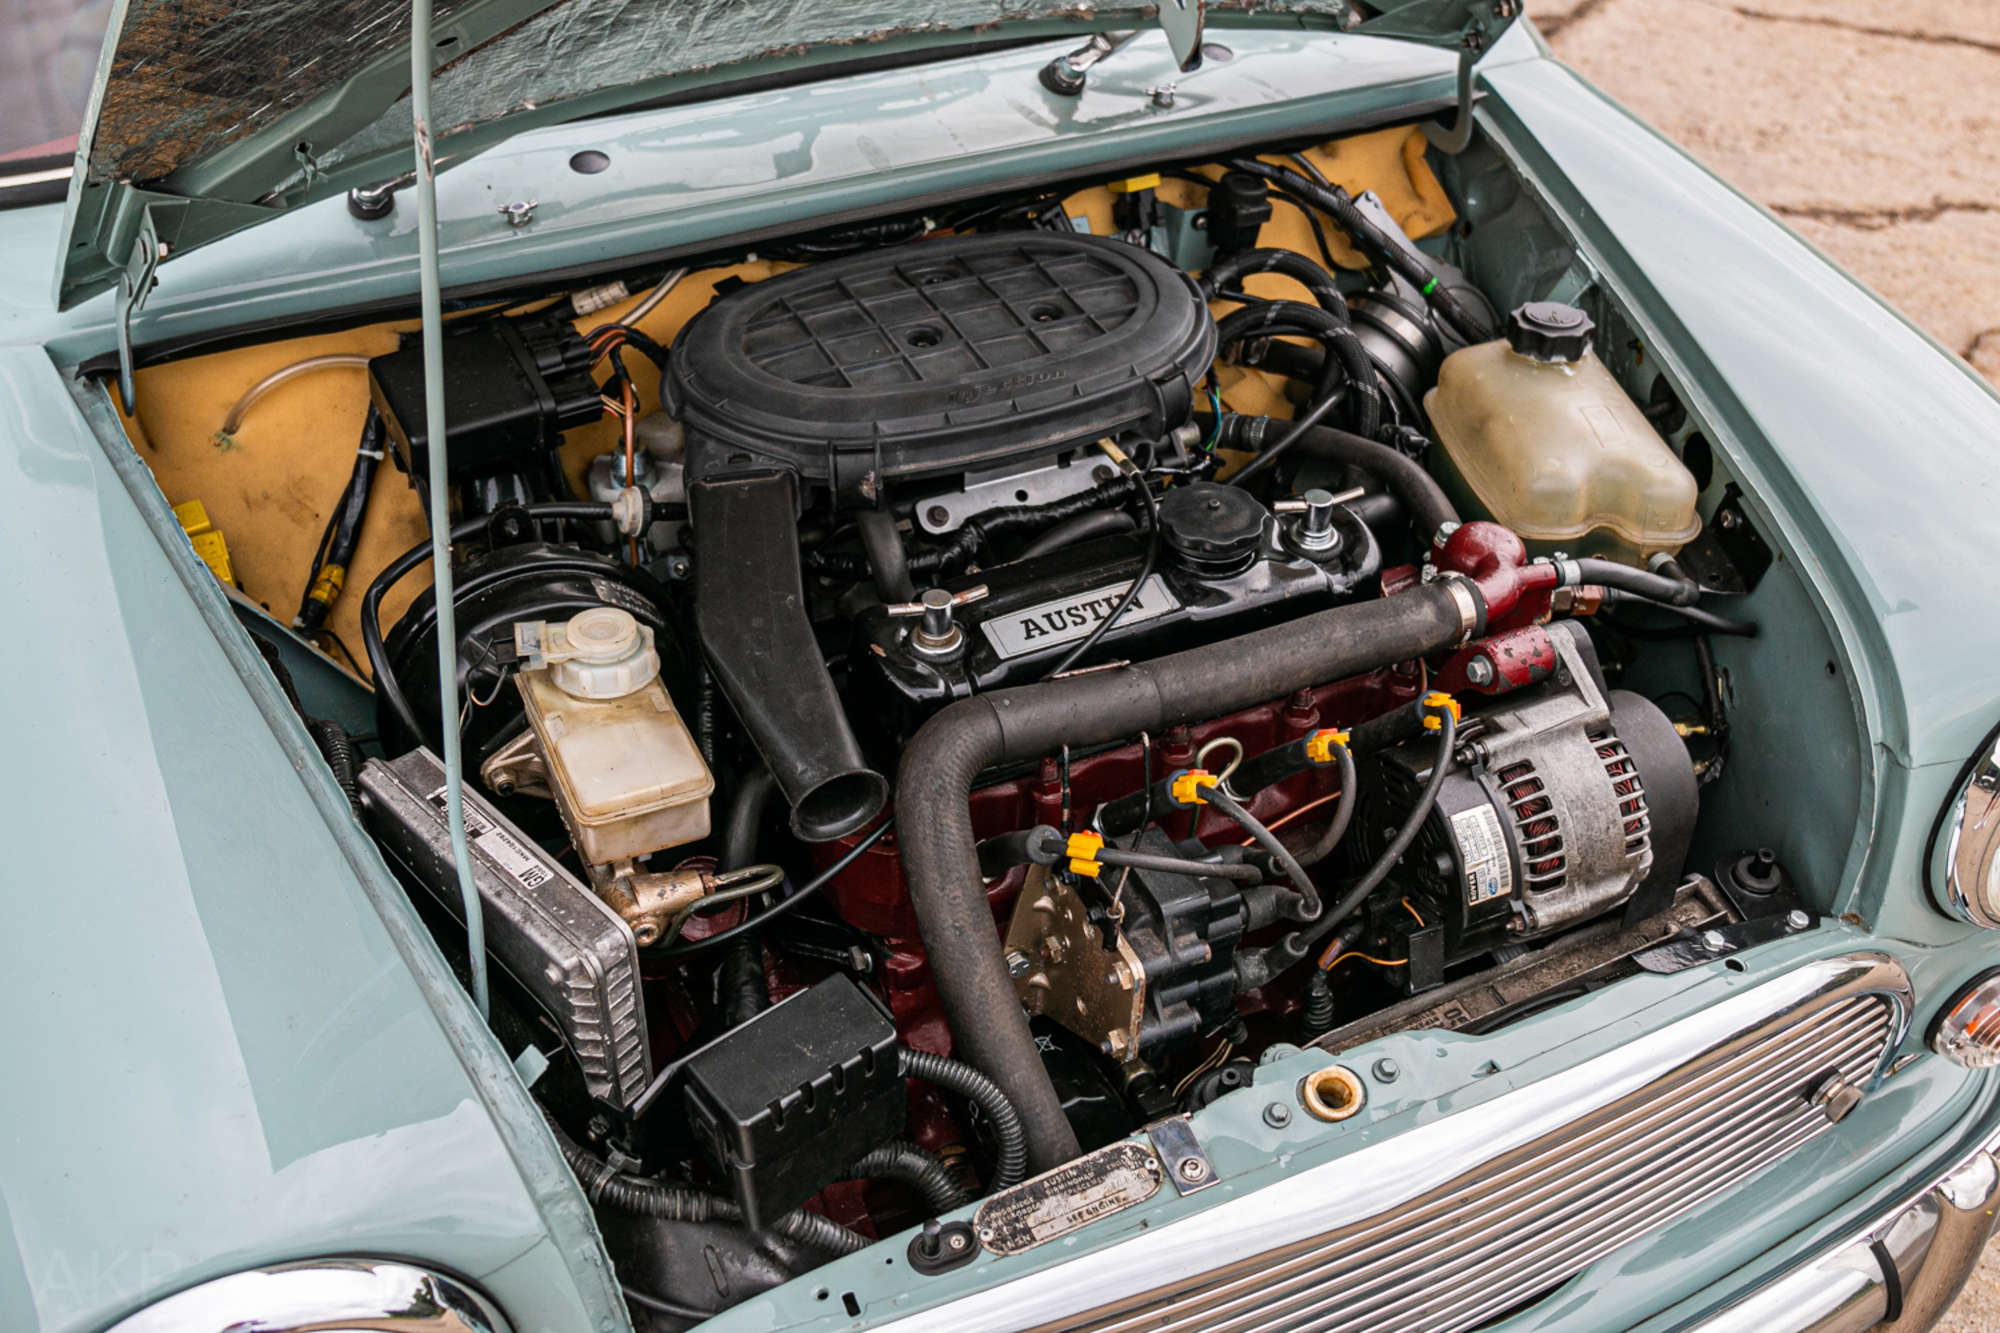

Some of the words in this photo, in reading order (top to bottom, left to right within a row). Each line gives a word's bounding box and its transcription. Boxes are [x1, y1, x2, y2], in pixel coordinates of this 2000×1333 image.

[1020, 594, 1144, 640] AUSTIN
[518, 865, 545, 888] GM
[1043, 1169, 1078, 1188] AUSTIN
